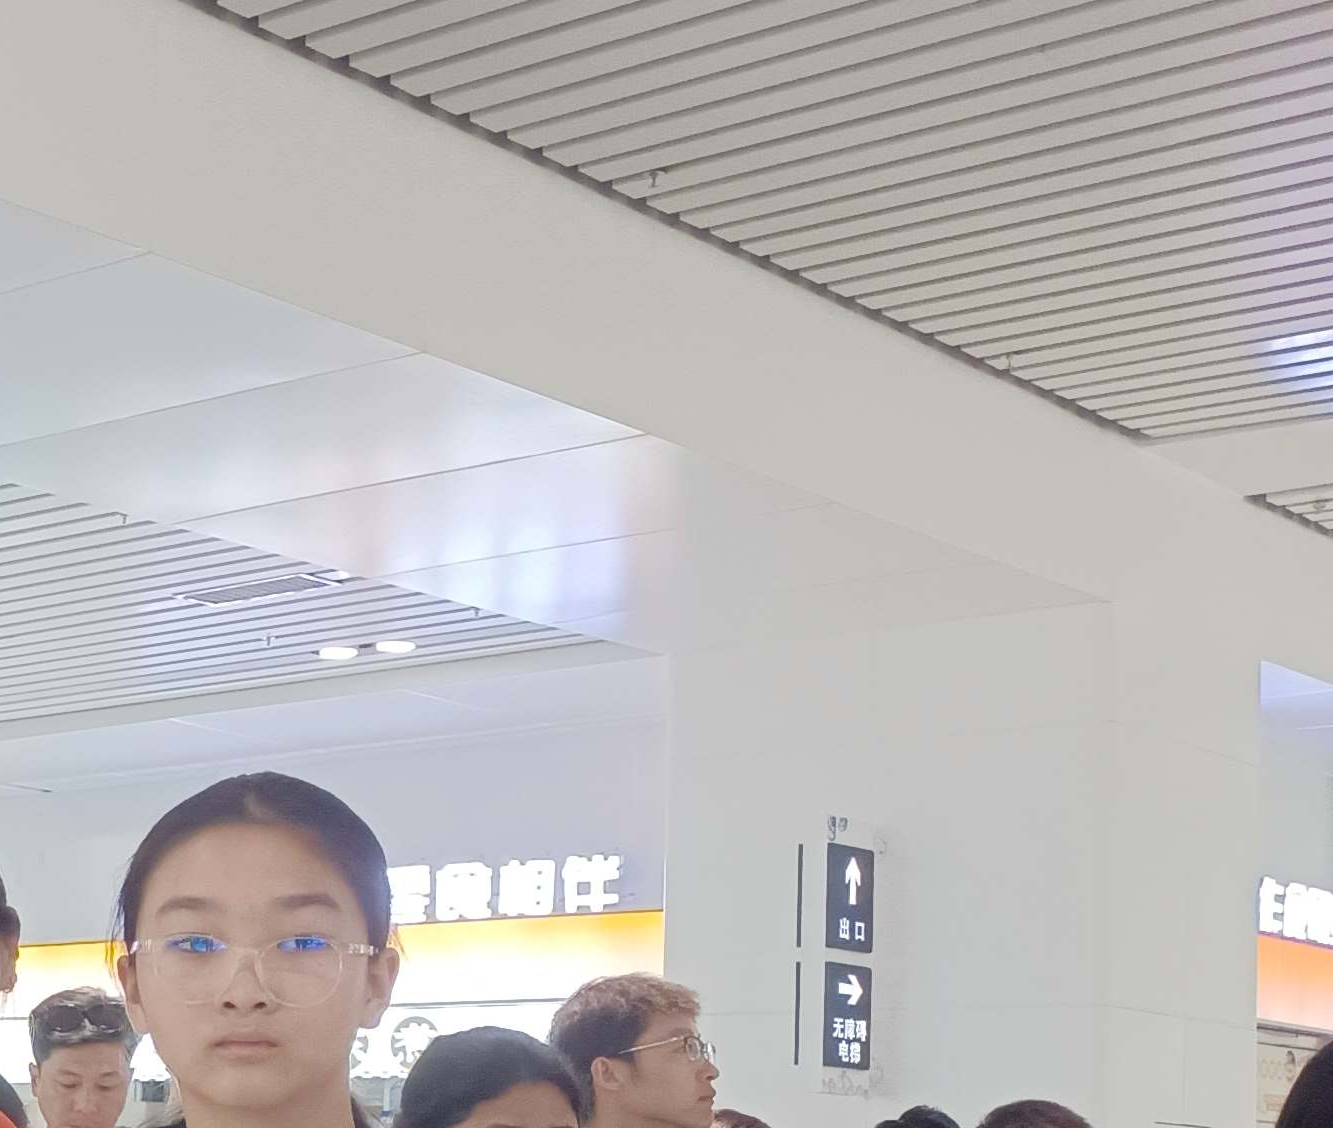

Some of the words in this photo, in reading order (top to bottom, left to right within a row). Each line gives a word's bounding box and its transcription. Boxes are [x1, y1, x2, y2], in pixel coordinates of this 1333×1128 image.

[837, 917, 866, 941] 出口
[832, 1017, 867, 1042] 无障碍
[837, 1041, 862, 1065] 电梯
